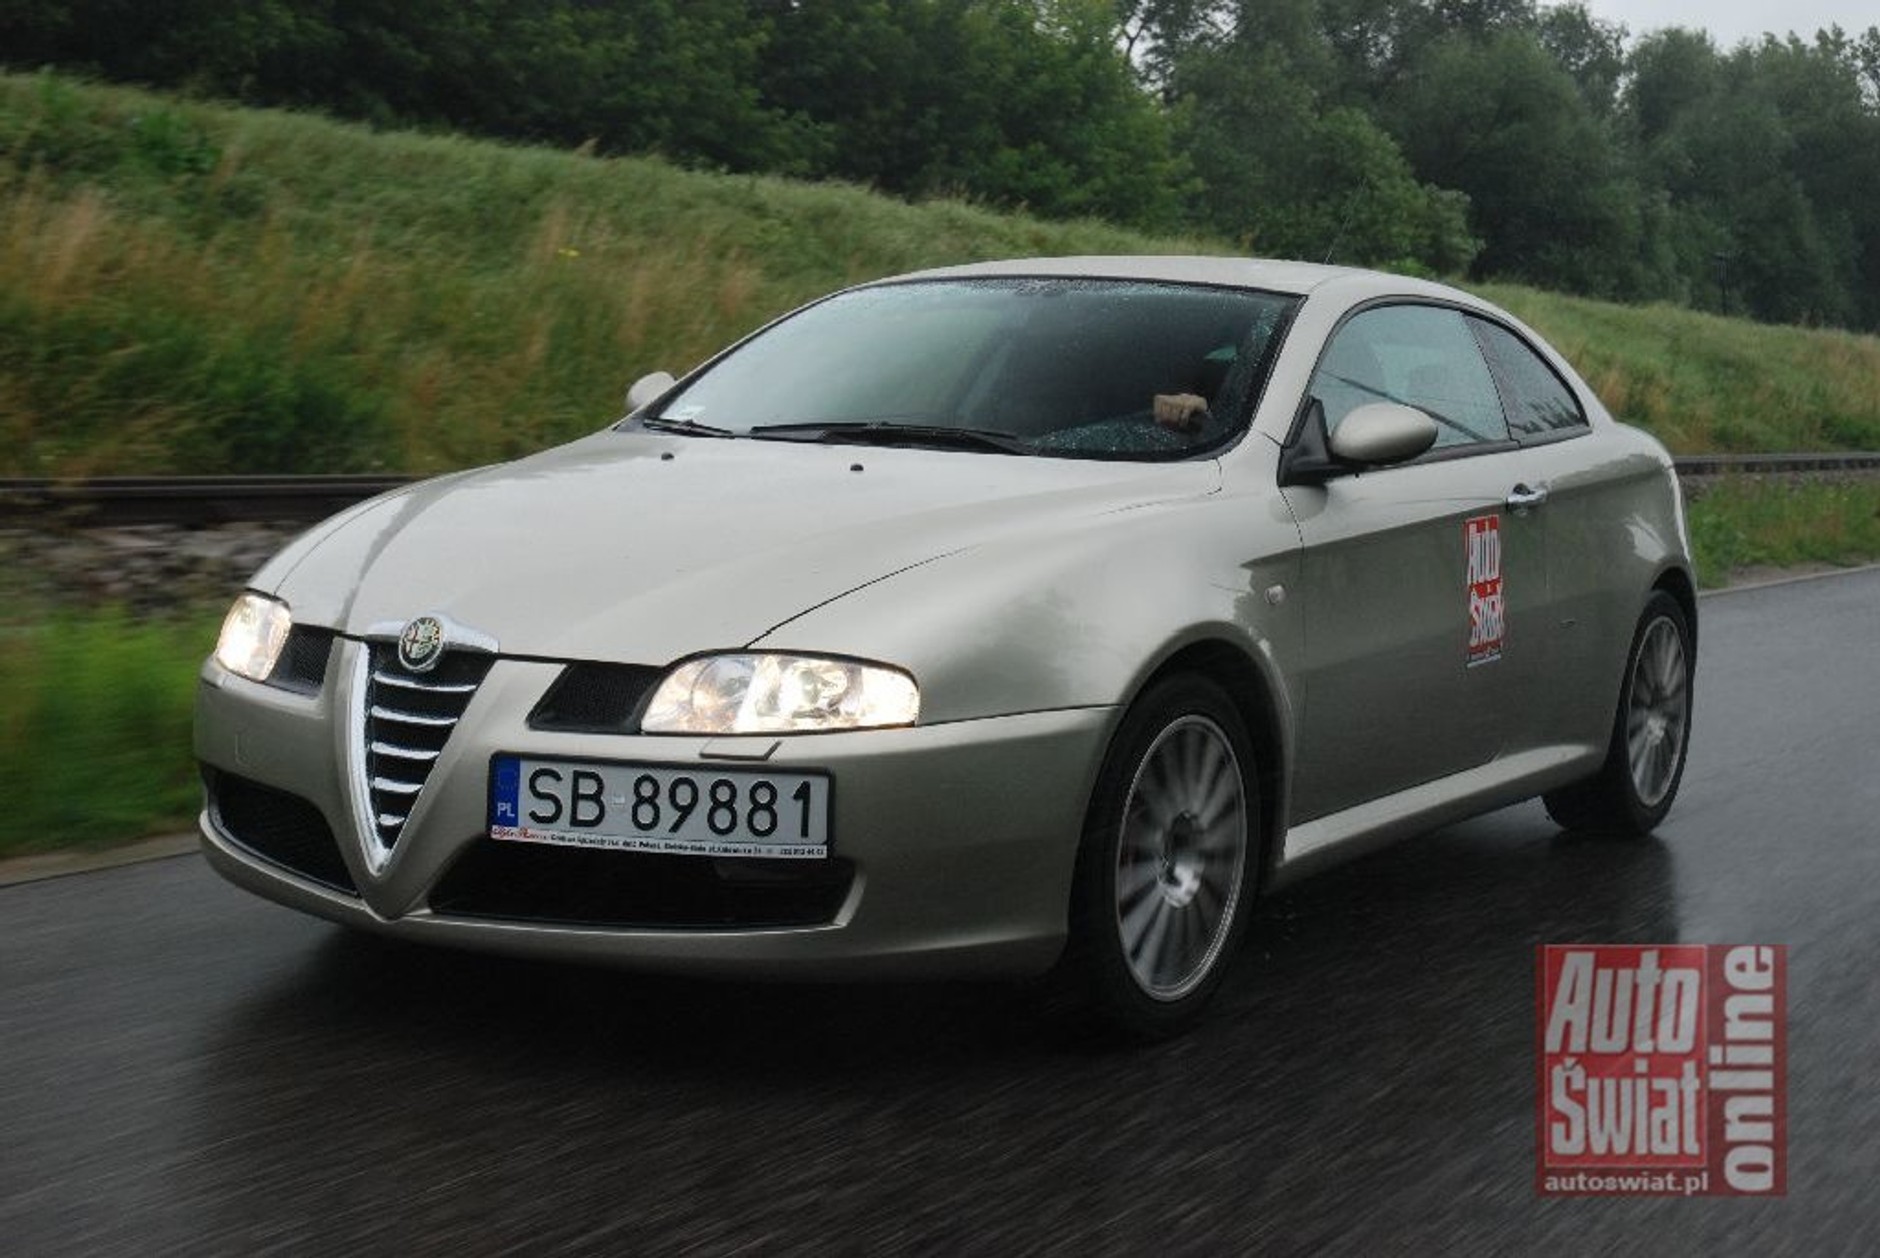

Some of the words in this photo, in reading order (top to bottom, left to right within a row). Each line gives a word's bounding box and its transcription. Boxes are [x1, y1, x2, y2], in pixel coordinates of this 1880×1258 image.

[497, 802, 515, 818] PL
[528, 767, 606, 828] SB
[631, 773, 811, 838] 89881
